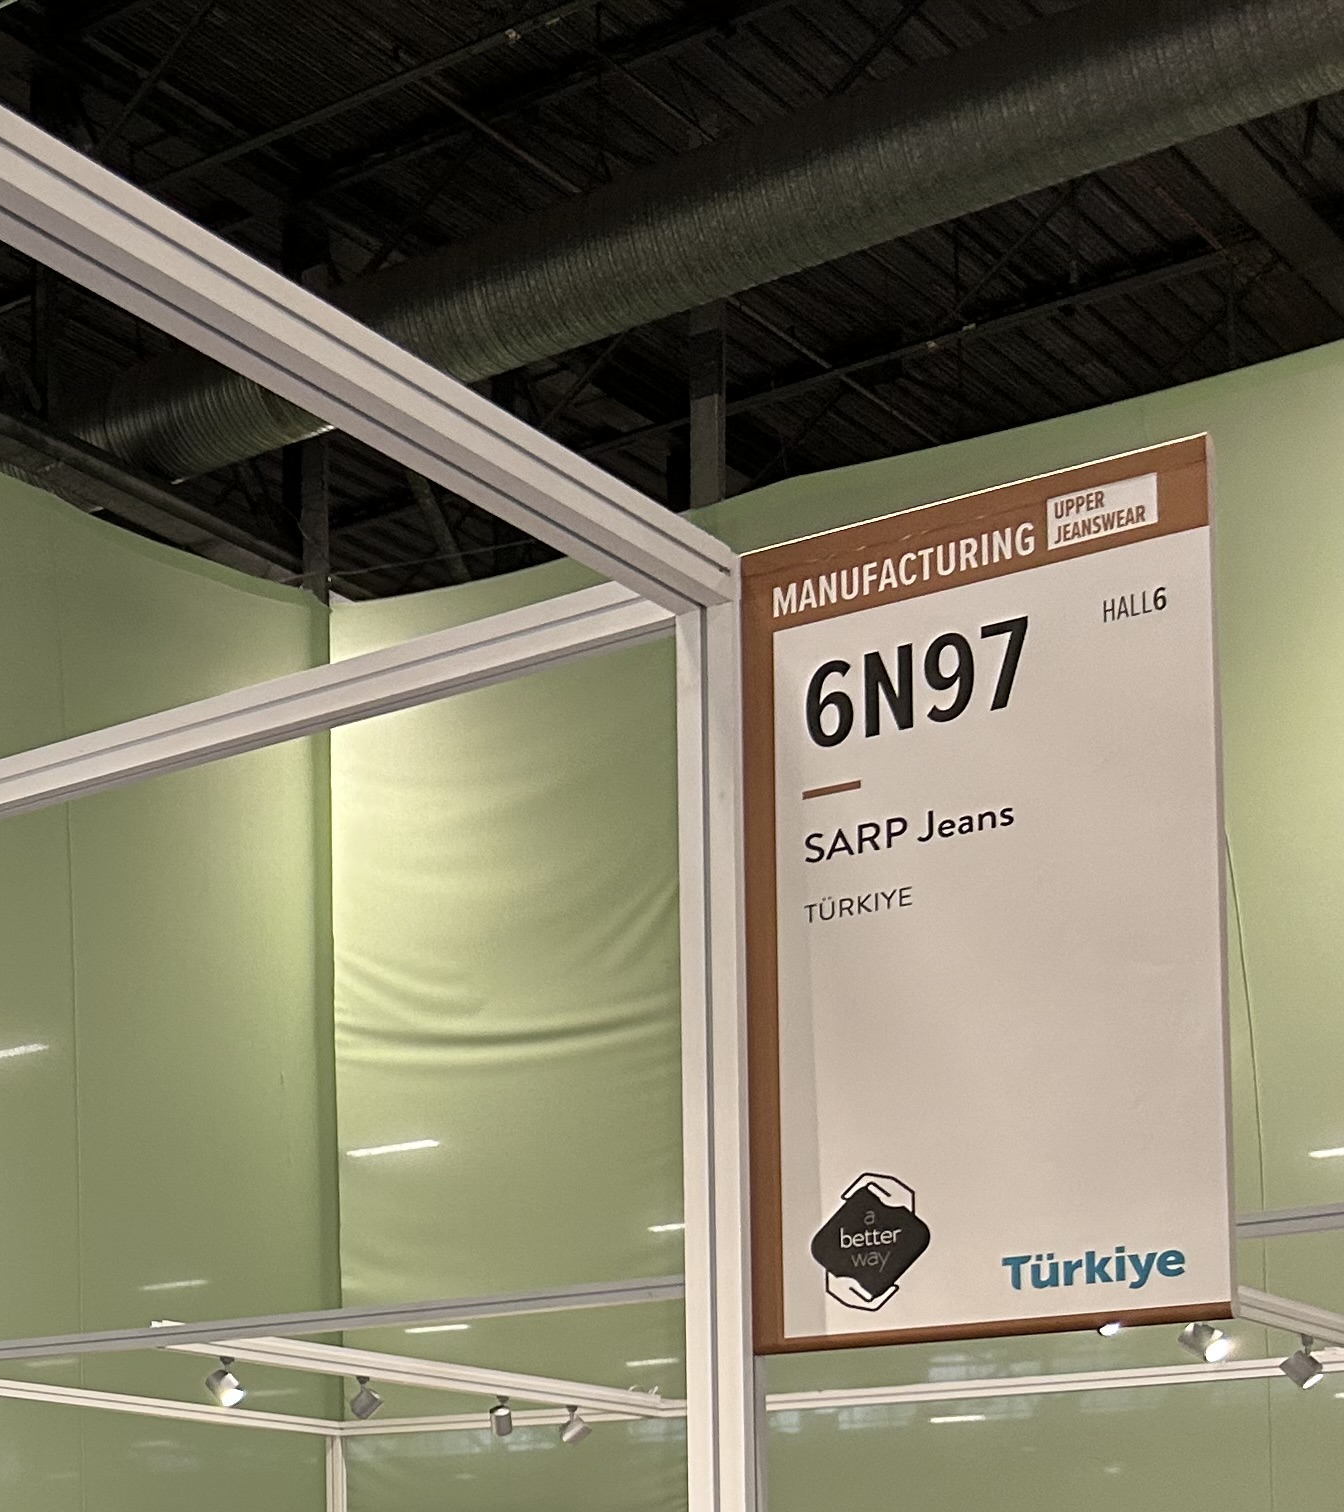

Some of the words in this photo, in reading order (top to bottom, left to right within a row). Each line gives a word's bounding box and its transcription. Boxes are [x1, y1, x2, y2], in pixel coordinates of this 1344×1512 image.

[1054, 490, 1105, 519] UPPER
[1054, 504, 1146, 545] JEANSWEAR
[772, 522, 1036, 618] MANUFACTURING
[805, 616, 1030, 749] 6N97
[804, 816, 908, 865] SARP
[917, 804, 1015, 844] Jeans
[804, 886, 913, 923] TÜRKIYE
[864, 1210, 875, 1226] a
[840, 1227, 903, 1249] better
[851, 1250, 891, 1273] way
[1002, 1245, 1185, 1290] Türkiye
